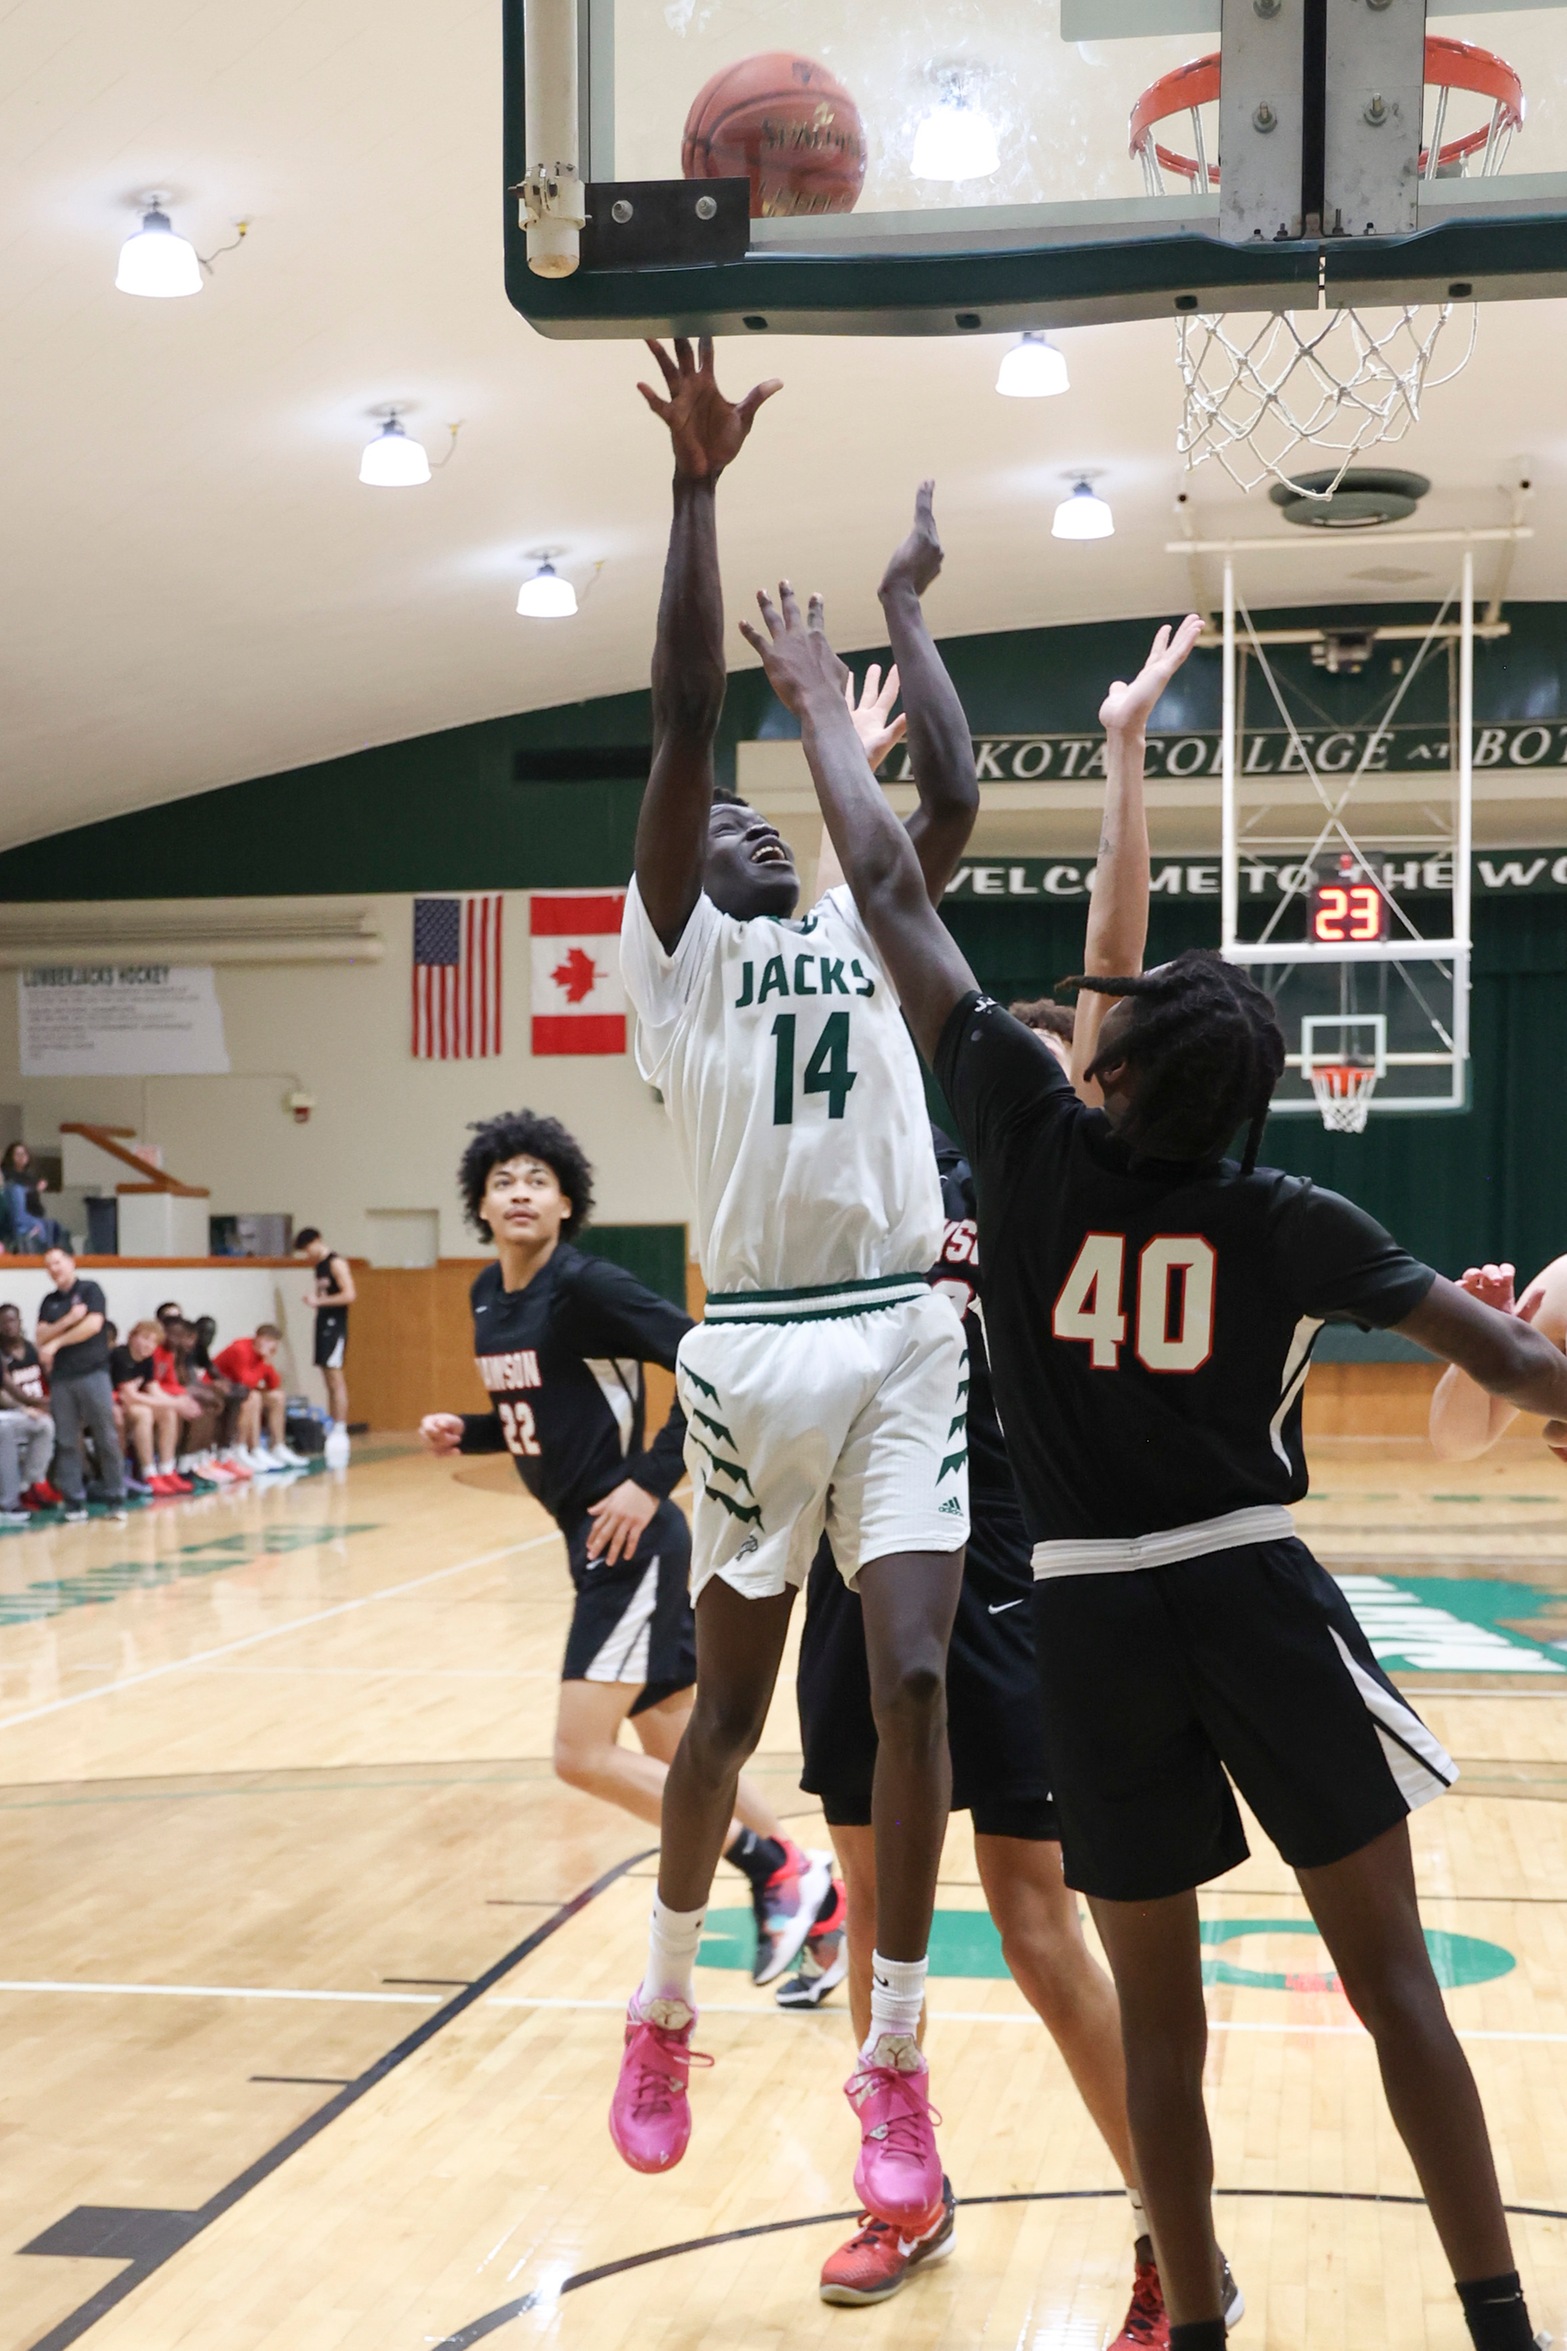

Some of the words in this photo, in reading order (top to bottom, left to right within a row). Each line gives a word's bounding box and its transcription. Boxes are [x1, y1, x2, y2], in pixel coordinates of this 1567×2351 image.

[1315, 886, 1380, 940] 23
[735, 953, 876, 1009] JACKS
[770, 1011, 858, 1126] 14
[1052, 1230, 1218, 1375] 40
[498, 1400, 542, 1456] 22
